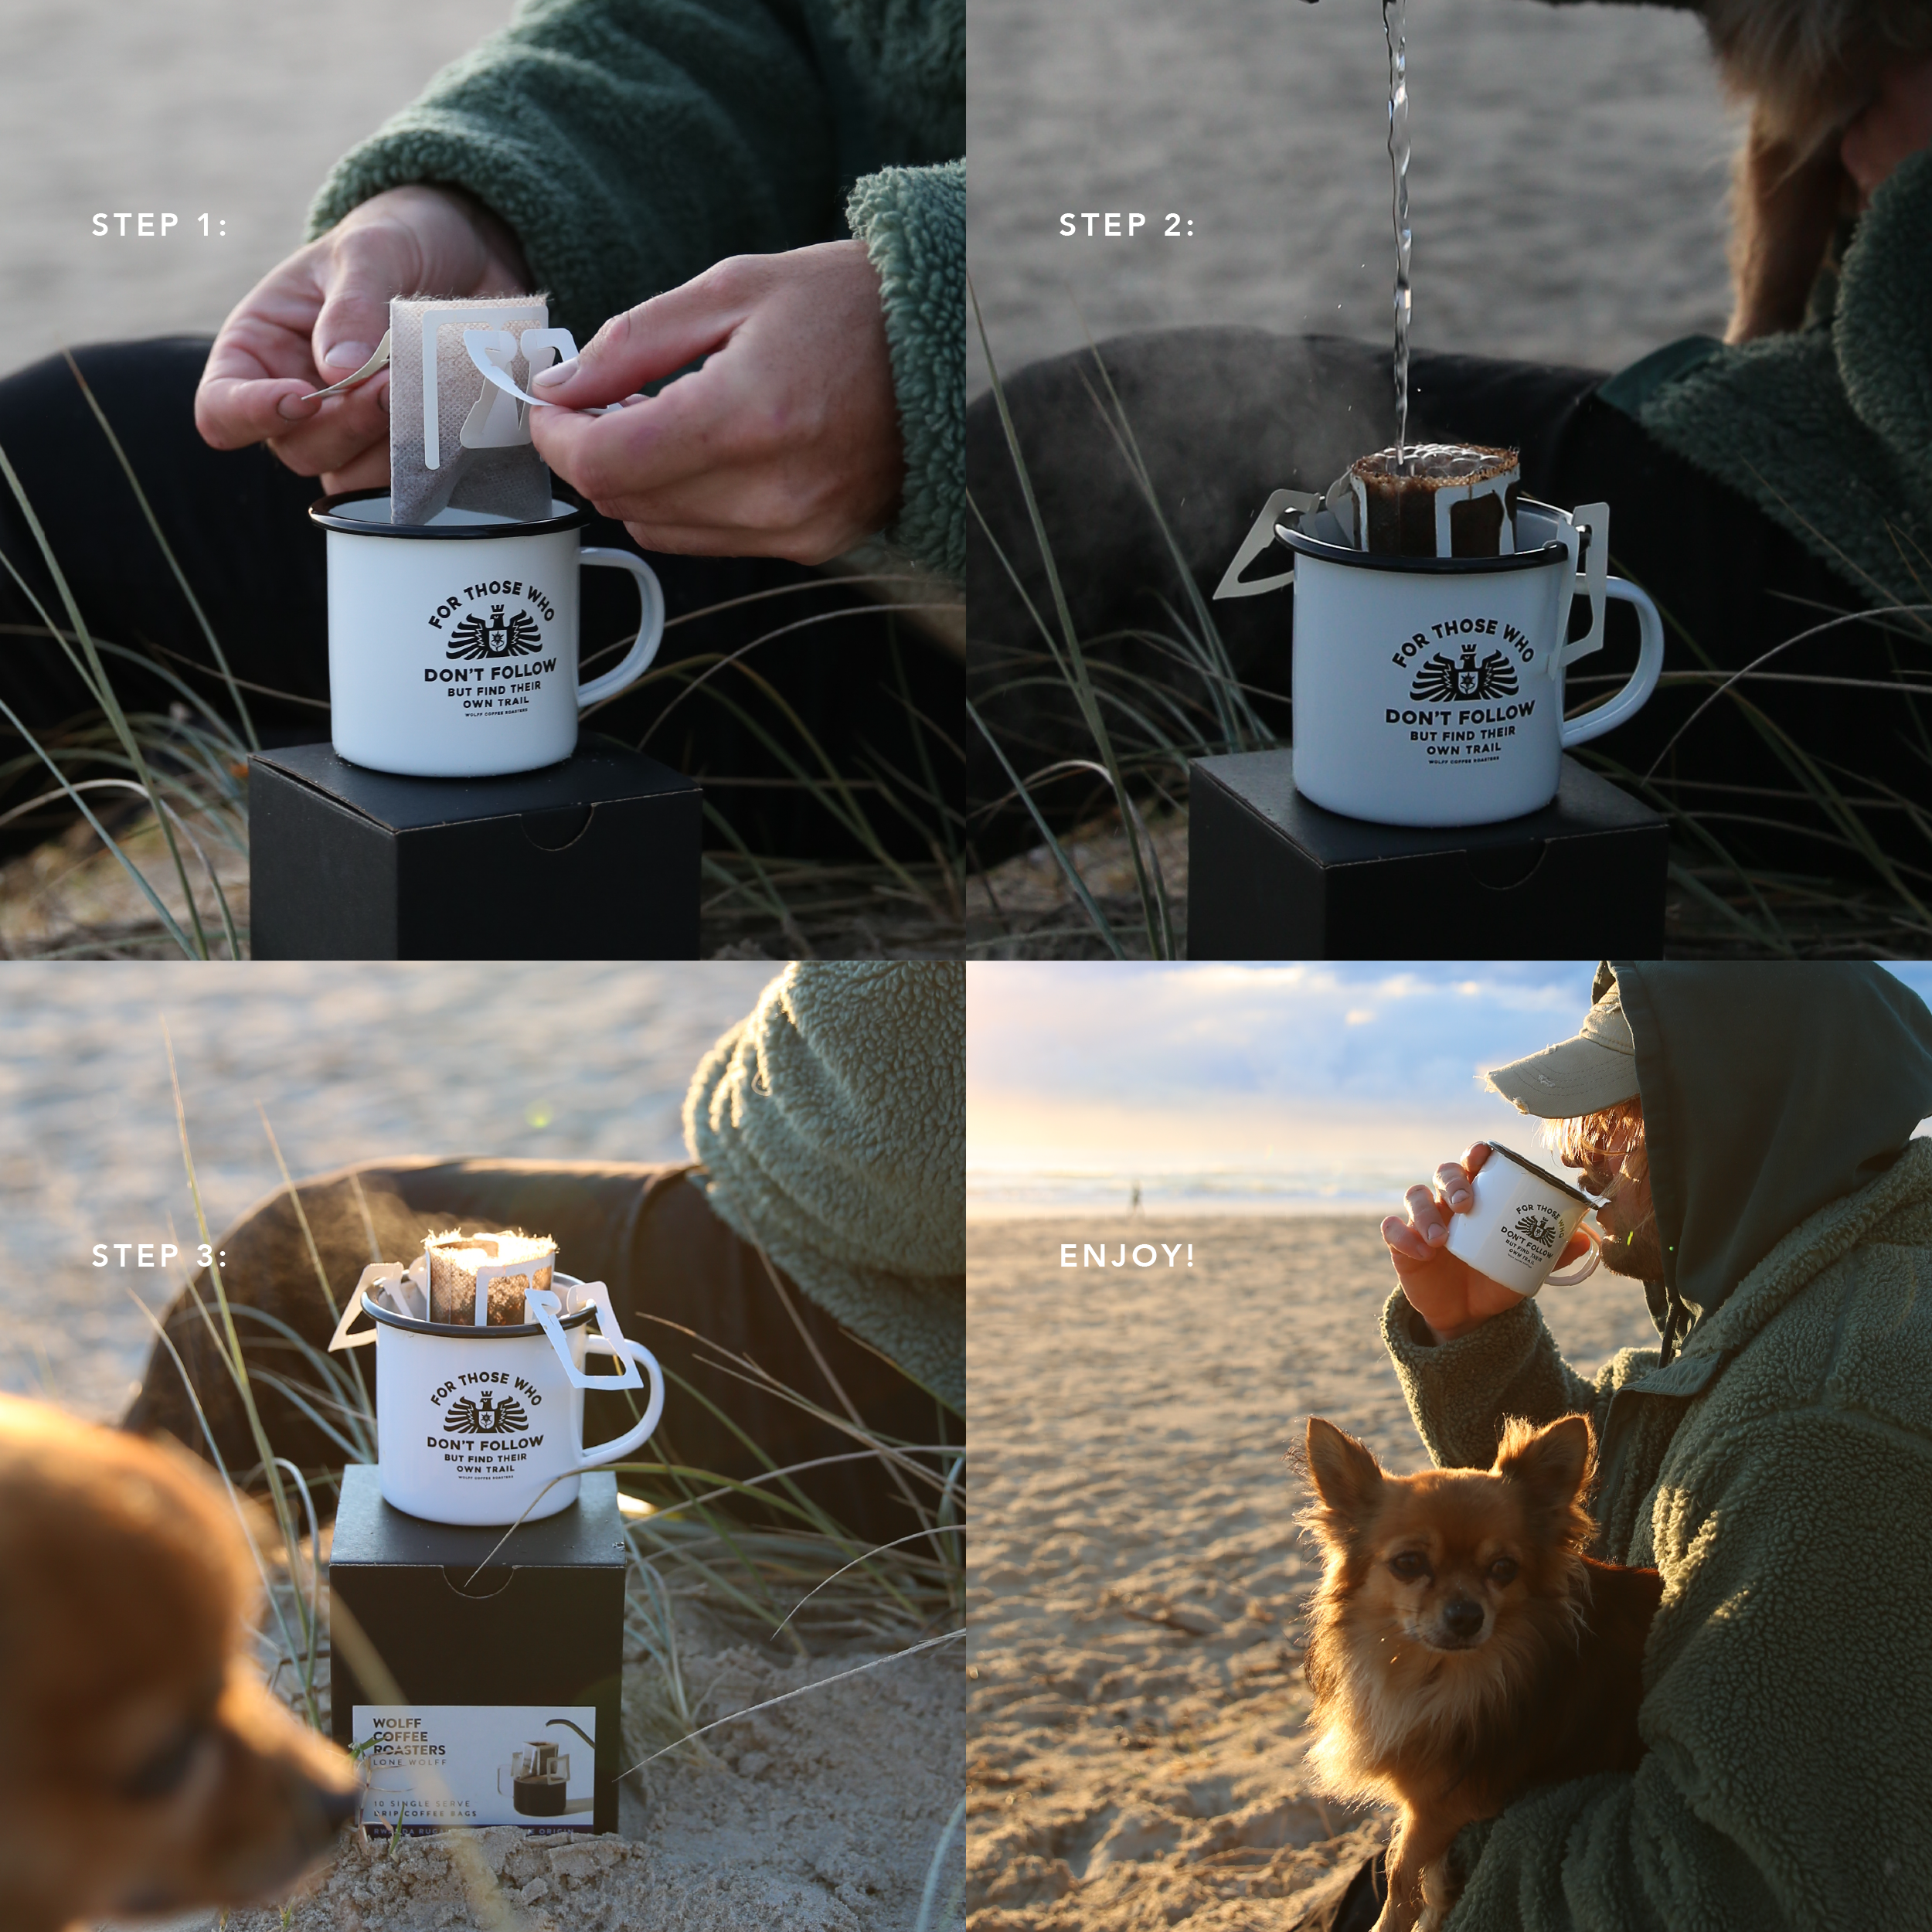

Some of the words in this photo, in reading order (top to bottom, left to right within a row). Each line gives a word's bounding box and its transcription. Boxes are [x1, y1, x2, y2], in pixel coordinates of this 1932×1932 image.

[428, 596, 463, 629] FOR
[464, 580, 522, 600] THOSE
[527, 585, 555, 621] WHO
[1392, 633, 1430, 668] FOR
[1431, 618, 1498, 639] THOSE
[1502, 624, 1535, 663] WHO
[424, 668, 485, 682] DON'T
[491, 657, 556, 681] FOLLOW
[447, 687, 472, 697] BUT
[477, 685, 505, 696] FIND
[510, 680, 541, 693] THEIR
[463, 699, 493, 709] OWN
[498, 696, 529, 707] TRAIL
[1385, 709, 1452, 726] DON'T
[1458, 699, 1536, 725] FOLLOW
[1410, 731, 1437, 741] BUT
[1442, 731, 1475, 742] FIND
[1480, 726, 1516, 740] THEIR
[1426, 746, 1460, 756] OWN
[1465, 743, 1502, 754] TRAIL
[1516, 1204, 1533, 1214] FOR
[1536, 1204, 1560, 1220] THOSE
[1500, 1226, 1526, 1244] DON'T
[1526, 1241, 1554, 1260] FOLLOW
[1509, 1248, 1522, 1258] OWN
[1517, 1246, 1530, 1255] FIND
[1530, 1253, 1543, 1263] THEIR
[430, 1380, 457, 1406] FOR
[457, 1371, 510, 1386] THOSE
[514, 1376, 543, 1406] WHO
[427, 1436, 474, 1451] DON'T
[480, 1434, 544, 1451] FOLLOW
[444, 1454, 464, 1462] BUT
[498, 1453, 527, 1462] THEIR
[372, 1718, 422, 1729] WOLFF
[373, 1731, 428, 1742] COFFEE
[373, 1745, 446, 1755] ROASTERS
